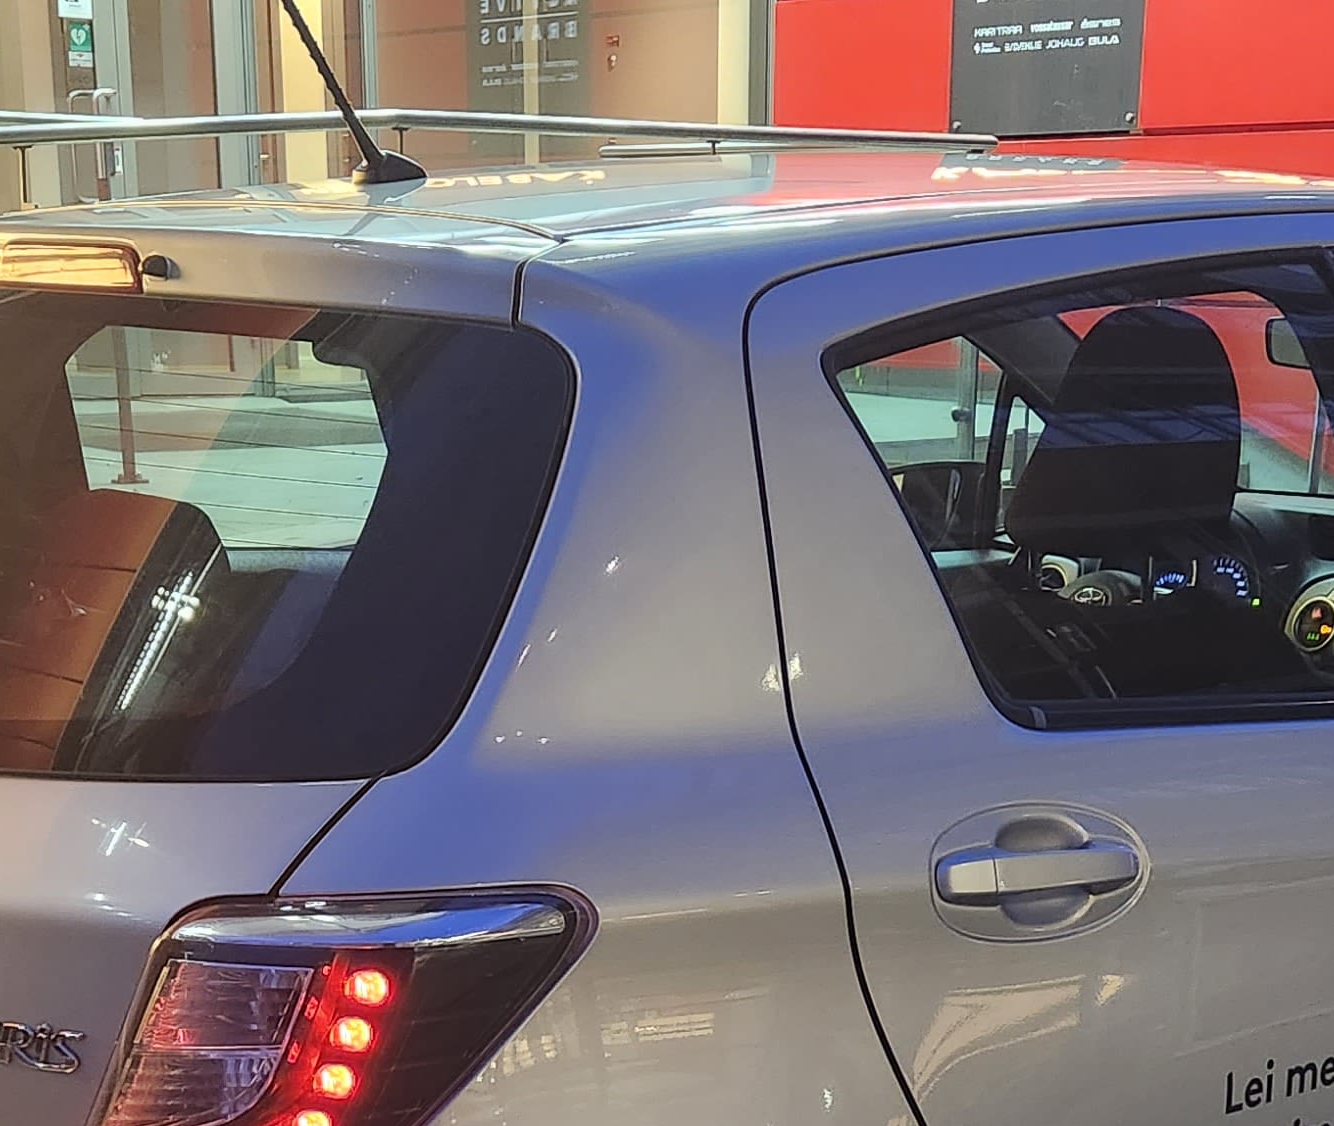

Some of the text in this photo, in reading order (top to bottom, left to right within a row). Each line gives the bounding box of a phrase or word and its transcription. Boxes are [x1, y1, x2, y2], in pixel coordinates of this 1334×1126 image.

[1045, 37, 1085, 49] JOHAUG
[1088, 34, 1120, 46] BULA
[1225, 1059, 1275, 1115] Lei
